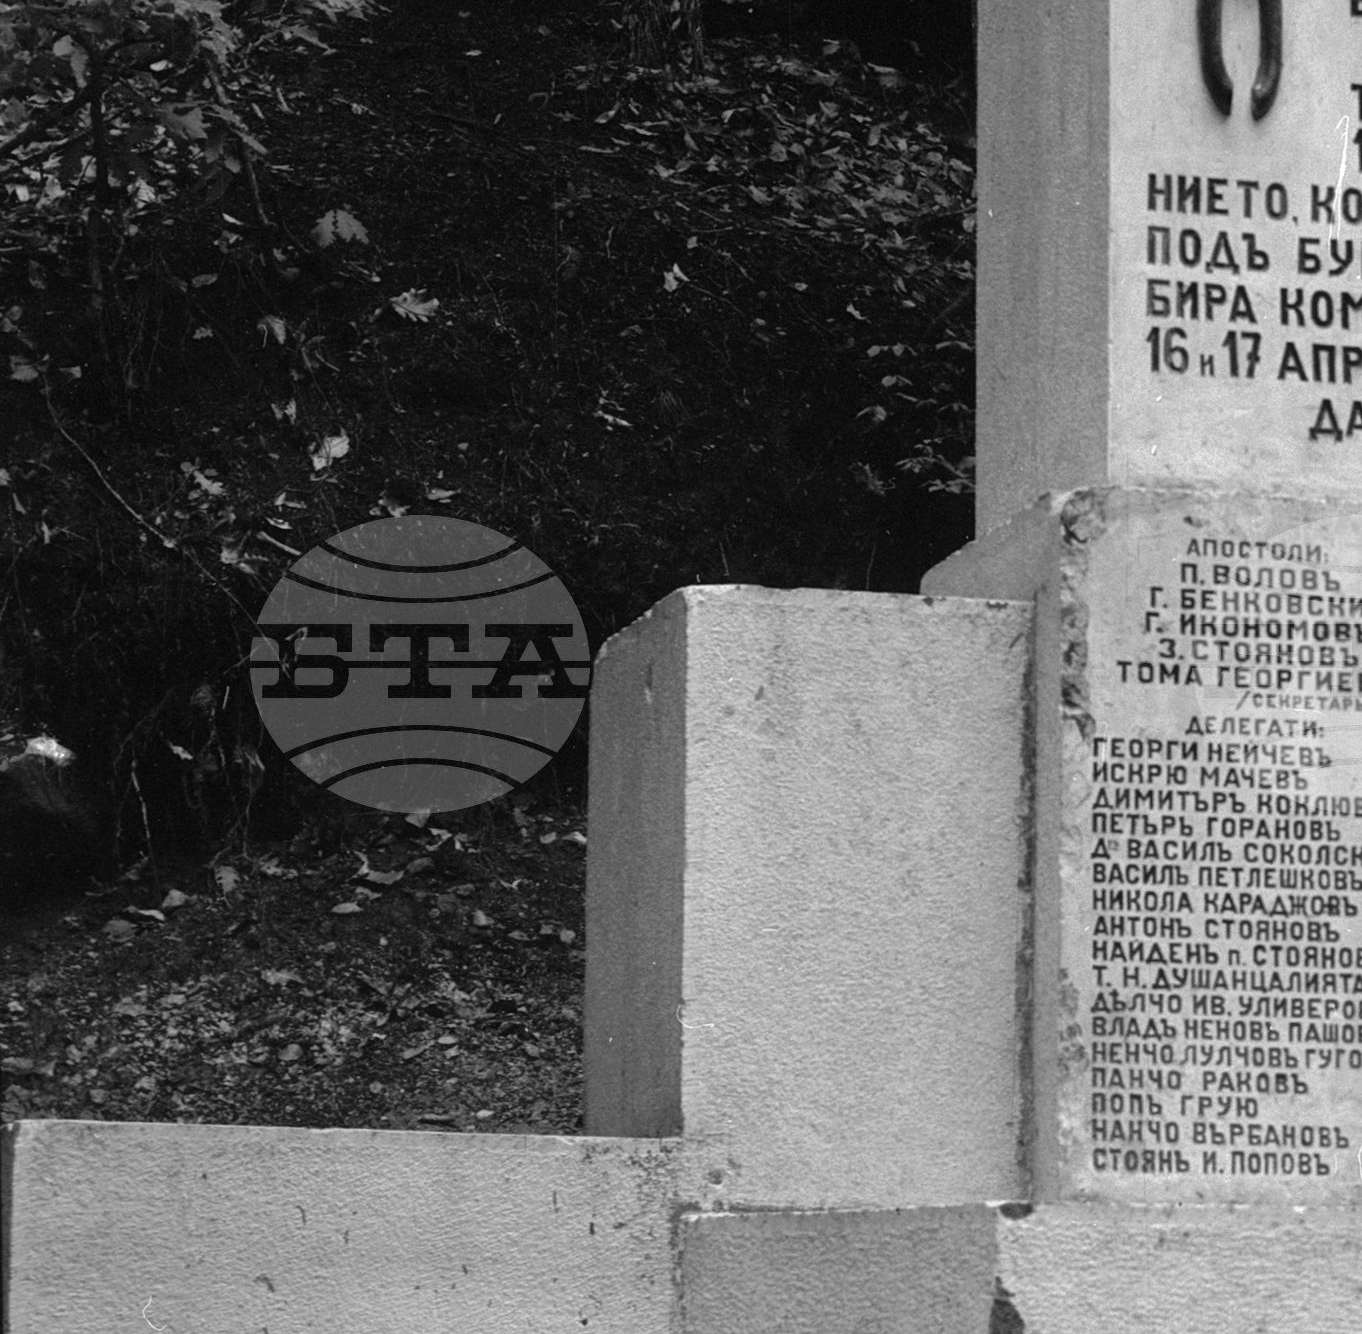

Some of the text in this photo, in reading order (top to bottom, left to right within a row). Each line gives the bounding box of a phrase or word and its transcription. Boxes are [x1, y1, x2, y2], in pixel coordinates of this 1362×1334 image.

[1148, 226, 1270, 273] ПОДЪ
[1146, 279, 1258, 325] БИРА
[1146, 326, 1190, 373] 16
[1222, 330, 1262, 379] 17
[1186, 539, 1329, 564] АПОСТОЛИ:
[1180, 564, 1341, 592] П. ВОЛОВЪ
[1150, 587, 1167, 609] Г.
[1145, 612, 1163, 633] Г.
[1192, 640, 1359, 668] СТОЯНОВЪ
[1117, 661, 1203, 686] ТОМА
[1186, 716, 1324, 738] ДЕЛЕГАТИ:
[1092, 762, 1308, 791] ИСКРЮ МАЧЕВЪ
[1092, 787, 1245, 814] ДИМИТЪРЪ
[1092, 814, 1341, 842] ПЕТЪРЪ ГОРАНОВЪ
[1092, 915, 1340, 942] АНТОНЪ СТОЯНОВЪ
[1092, 1016, 1177, 1041] ВЛАДЪ
[1184, 1019, 1280, 1043] НЕНОВЪ
[1092, 1041, 1175, 1066] НЕНЧО
[1179, 1045, 1299, 1068] ЛУЛЧОВЪ
[1092, 1068, 1309, 1095] ПАНЧО РАКОВЪ
[1092, 1093, 1259, 1118] ПОПЪ ГРУЮ
[1092, 1119, 1350, 1149] НАНЧО ВЪРБАНОВЪ
[1092, 1148, 1191, 1173] СТОЯНЪ
[1231, 1150, 1331, 1176] ПОПОВЪ
